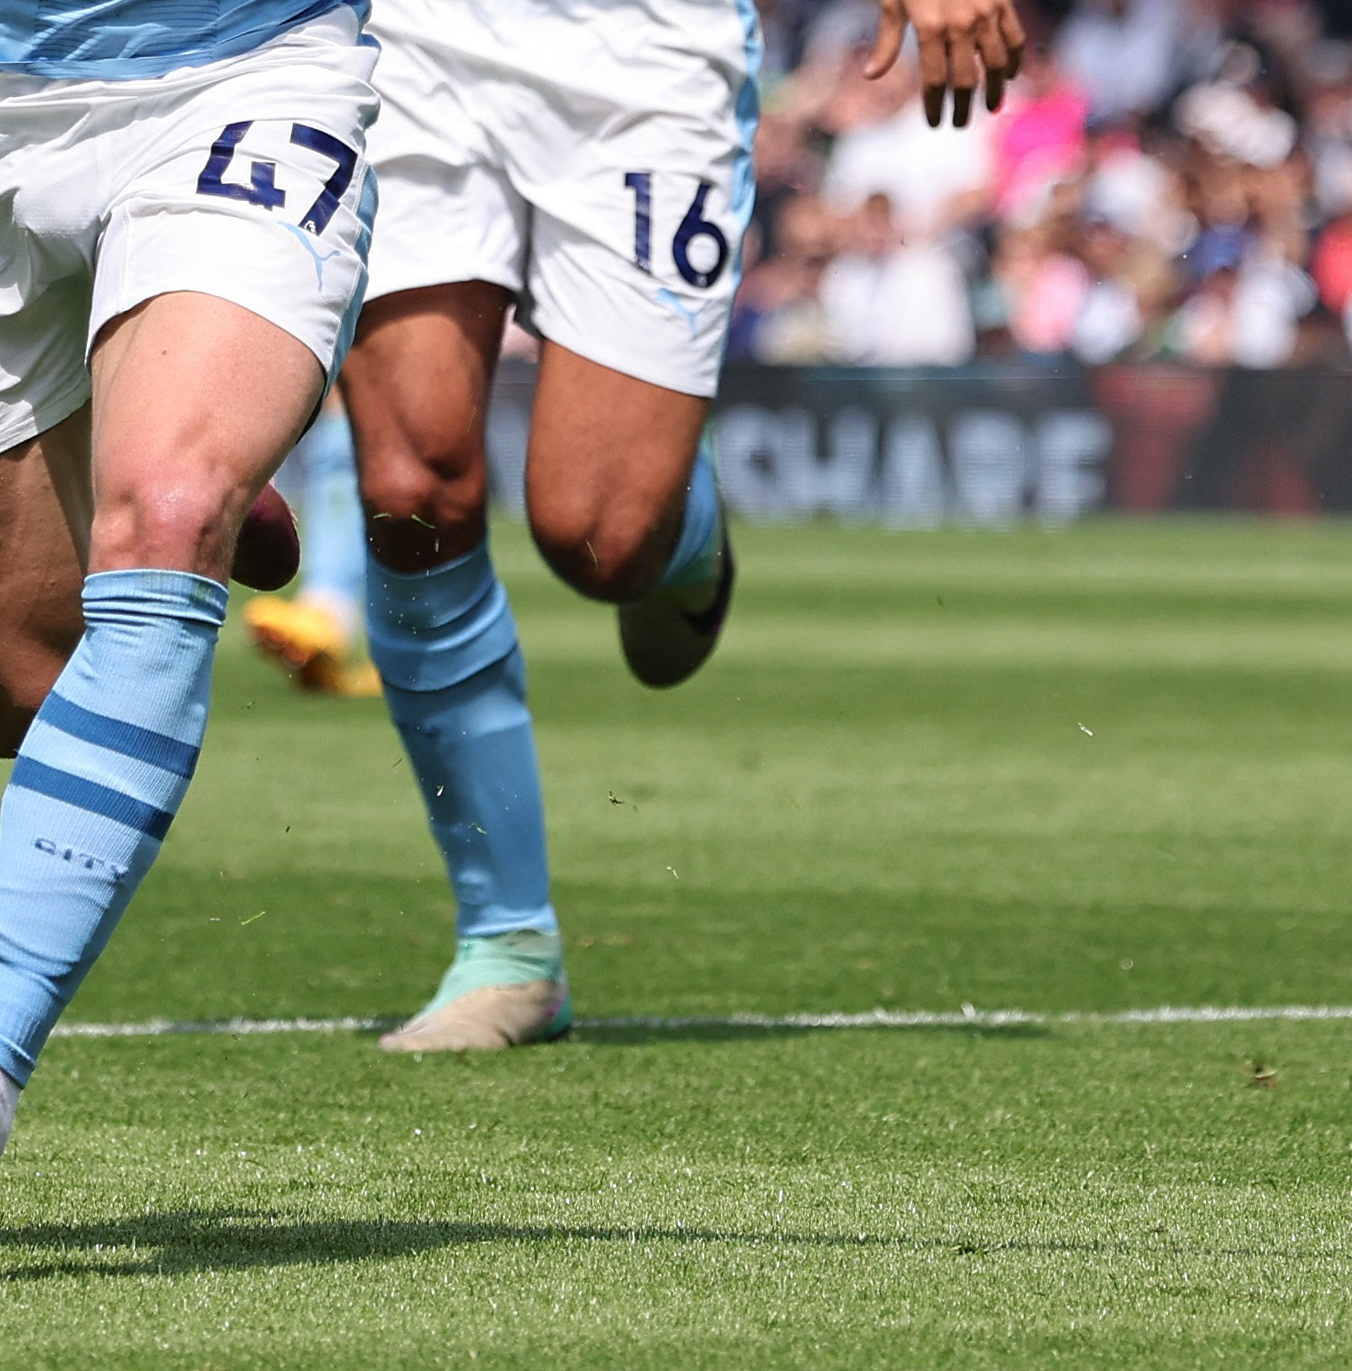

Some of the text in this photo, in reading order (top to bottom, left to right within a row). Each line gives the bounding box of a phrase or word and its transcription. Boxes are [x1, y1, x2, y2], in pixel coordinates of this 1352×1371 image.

[196, 120, 359, 236] 47
[624, 172, 729, 288] 16
[34, 836, 129, 880] CITY
